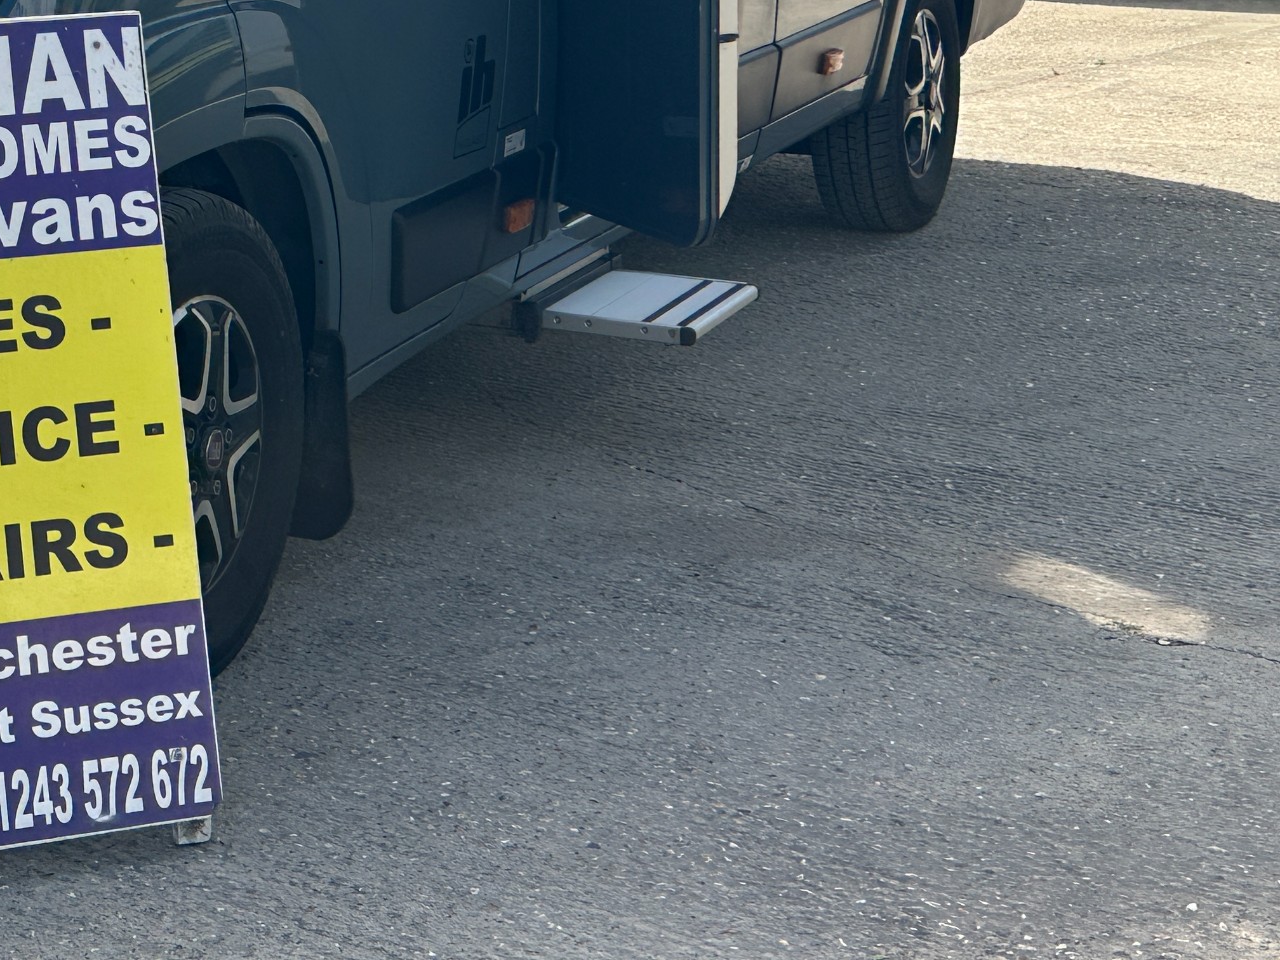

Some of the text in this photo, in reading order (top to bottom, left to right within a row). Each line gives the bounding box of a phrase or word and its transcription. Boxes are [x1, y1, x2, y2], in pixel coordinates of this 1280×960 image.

[31, 690, 204, 739] Sussex
[82, 753, 144, 822] 572
[151, 744, 212, 809] 672
